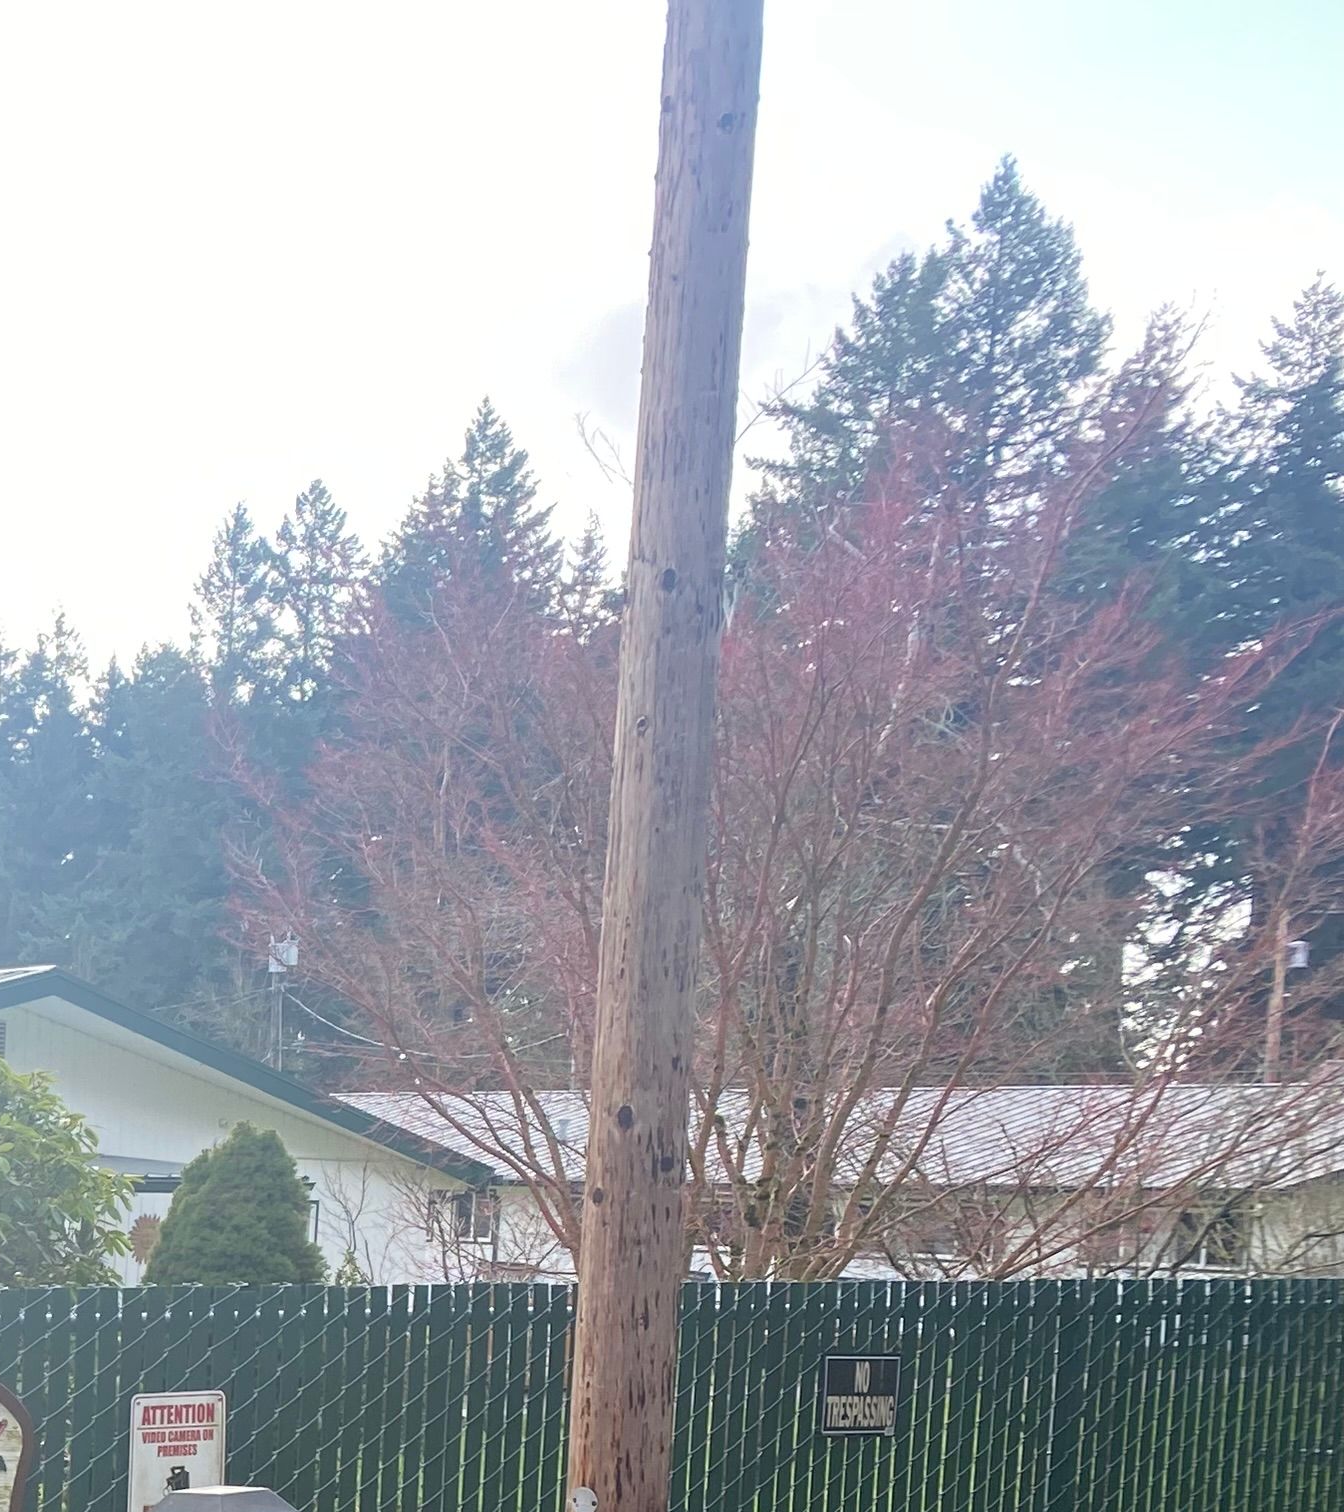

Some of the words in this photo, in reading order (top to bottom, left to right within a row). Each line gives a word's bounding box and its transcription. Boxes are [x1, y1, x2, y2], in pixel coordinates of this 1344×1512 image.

[854, 1361, 870, 1393] NO
[141, 1403, 215, 1425] ATTENTION
[826, 1396, 894, 1428] TRESPASSING
[142, 1432, 166, 1444] VIDEO
[168, 1430, 201, 1442] CAMERA
[203, 1429, 214, 1441] ON
[157, 1444, 198, 1457] PREMISES
